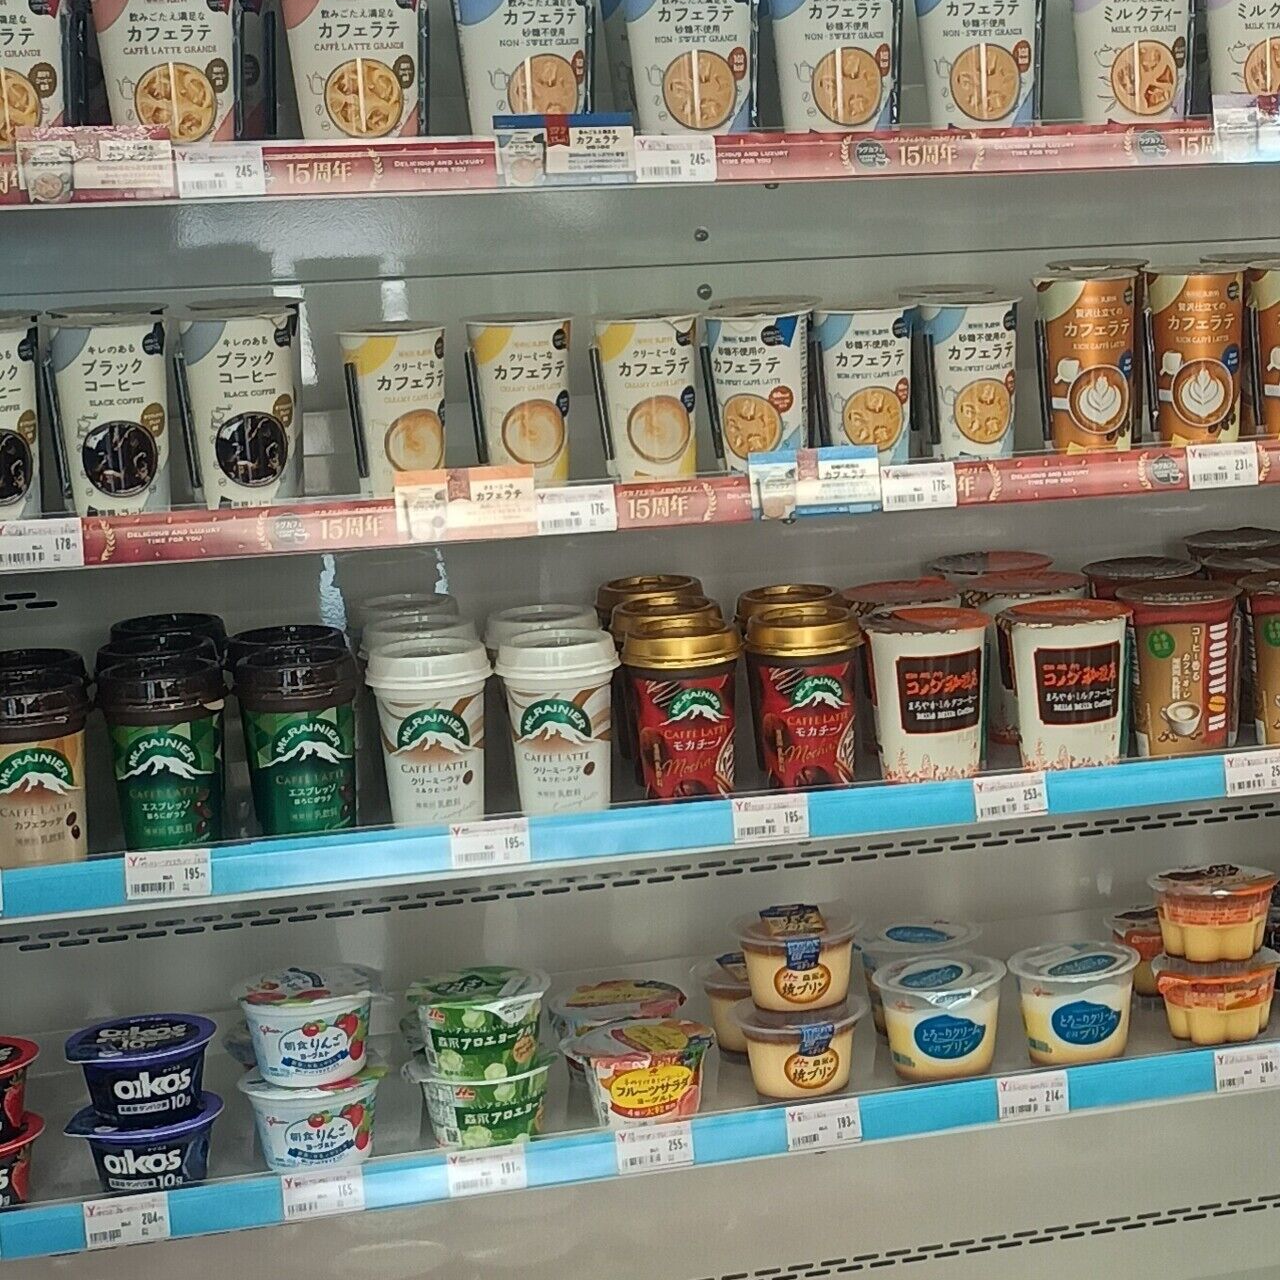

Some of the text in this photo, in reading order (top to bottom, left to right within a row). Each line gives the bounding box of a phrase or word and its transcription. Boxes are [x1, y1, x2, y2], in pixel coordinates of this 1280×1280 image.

[503, 9, 577, 25] カフェラテ
[657, 6, 735, 23] カフェラテ
[809, 3, 882, 20] カフェラテ
[946, 0, 1020, 18] カフェラテ
[1104, 6, 1183, 23] ミルクティー
[127, 25, 212, 43] カフェラテ
[318, 21, 400, 39] カフェラテ
[899, 142, 958, 167] 15周年
[286, 160, 353, 185] 15周年
[1064, 318, 1130, 338] カフェラテ
[1167, 315, 1236, 332] カフェラテ
[217, 350, 275, 368] ブラック
[835, 350, 906, 368] カフェラテ
[948, 341, 1015, 360] カフェラテ
[82, 358, 143, 376] ブラック
[494, 360, 566, 380] カフェラテ
[618, 357, 691, 378] カフェラテ
[713, 356, 781, 375] カフェラテ
[84, 380, 146, 392] コーヒー
[219, 370, 278, 384] コーヒー
[626, 494, 689, 520] 15周年
[321, 515, 384, 541] 15周年
[795, 723, 845, 738] モカチーノ
[673, 737, 722, 752] モカチーノ
[288, 783, 337, 797] エスプレッソ
[141, 800, 192, 812] エスプレッソ
[782, 982, 826, 997] 焼プリン
[792, 1066, 835, 1082] 焼プリン
[616, 1077, 690, 1098] フルーツサラダ
